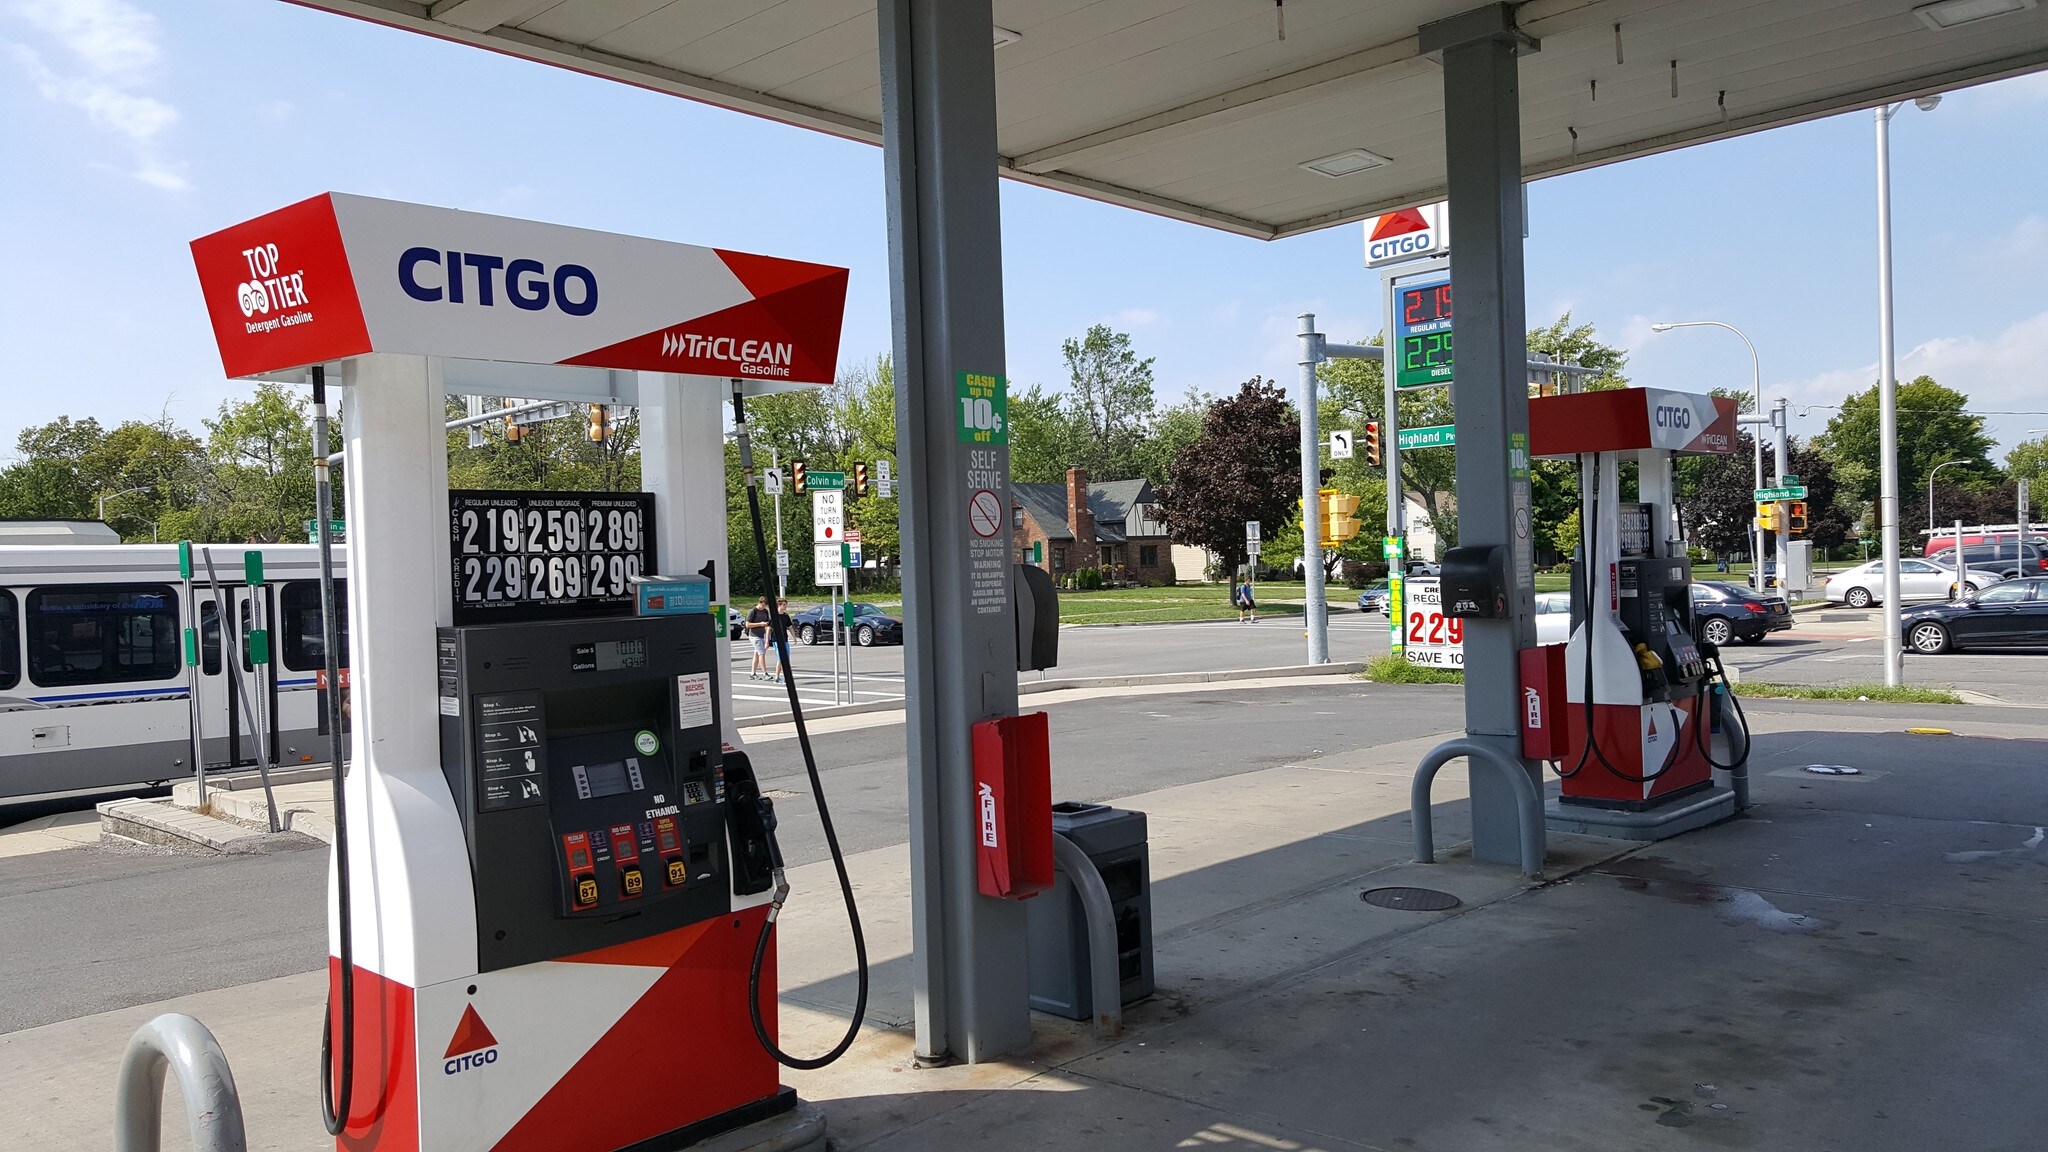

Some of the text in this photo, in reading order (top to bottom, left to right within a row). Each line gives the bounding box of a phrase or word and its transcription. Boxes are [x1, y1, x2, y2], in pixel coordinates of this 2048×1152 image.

[1370, 233, 1430, 259] CITGO
[242, 243, 279, 279] TOP
[398, 246, 599, 317] CITGO
[246, 311, 314, 334] Detergent Gasoline
[1410, 322, 1437, 334] REGULAR
[685, 333, 793, 366] TriCLEAN
[740, 361, 790, 377] Gasoline
[1431, 367, 1452, 377] DIESEL
[966, 373, 996, 388] CASH
[970, 387, 993, 398] up to
[960, 397, 1002, 433] 10¢
[1656, 405, 1690, 430] CITGO
[974, 430, 992, 442] off
[1399, 431, 1440, 448] Highland
[971, 450, 997, 470] SELF
[806, 476, 843, 487] Colvin Blvd
[967, 470, 1002, 490] SERVE
[822, 494, 835, 505] NO
[1756, 490, 1790, 501] Highland
[820, 506, 837, 515] TURN
[452, 509, 460, 542] CASH
[816, 517, 840, 526] ON RED
[970, 540, 1004, 548] NO SMOKING
[970, 548, 1004, 558] STOP MOTOR
[973, 560, 1002, 569] WARNING
[453, 557, 461, 602] CREDIT
[981, 571, 1005, 579] UNLAWFUL
[977, 606, 1002, 614] CONTAINER
[1407, 650, 1442, 664] SAVE
[685, 683, 704, 692] BEFORE
[1530, 697, 1538, 726] FIRE
[653, 795, 665, 804] NO
[646, 805, 680, 819] ETHANOL
[984, 799, 994, 842] FIRE
[671, 868, 684, 878] 91
[627, 877, 641, 888] 89
[581, 887, 595, 898] 87
[445, 1049, 498, 1075] CITGO
